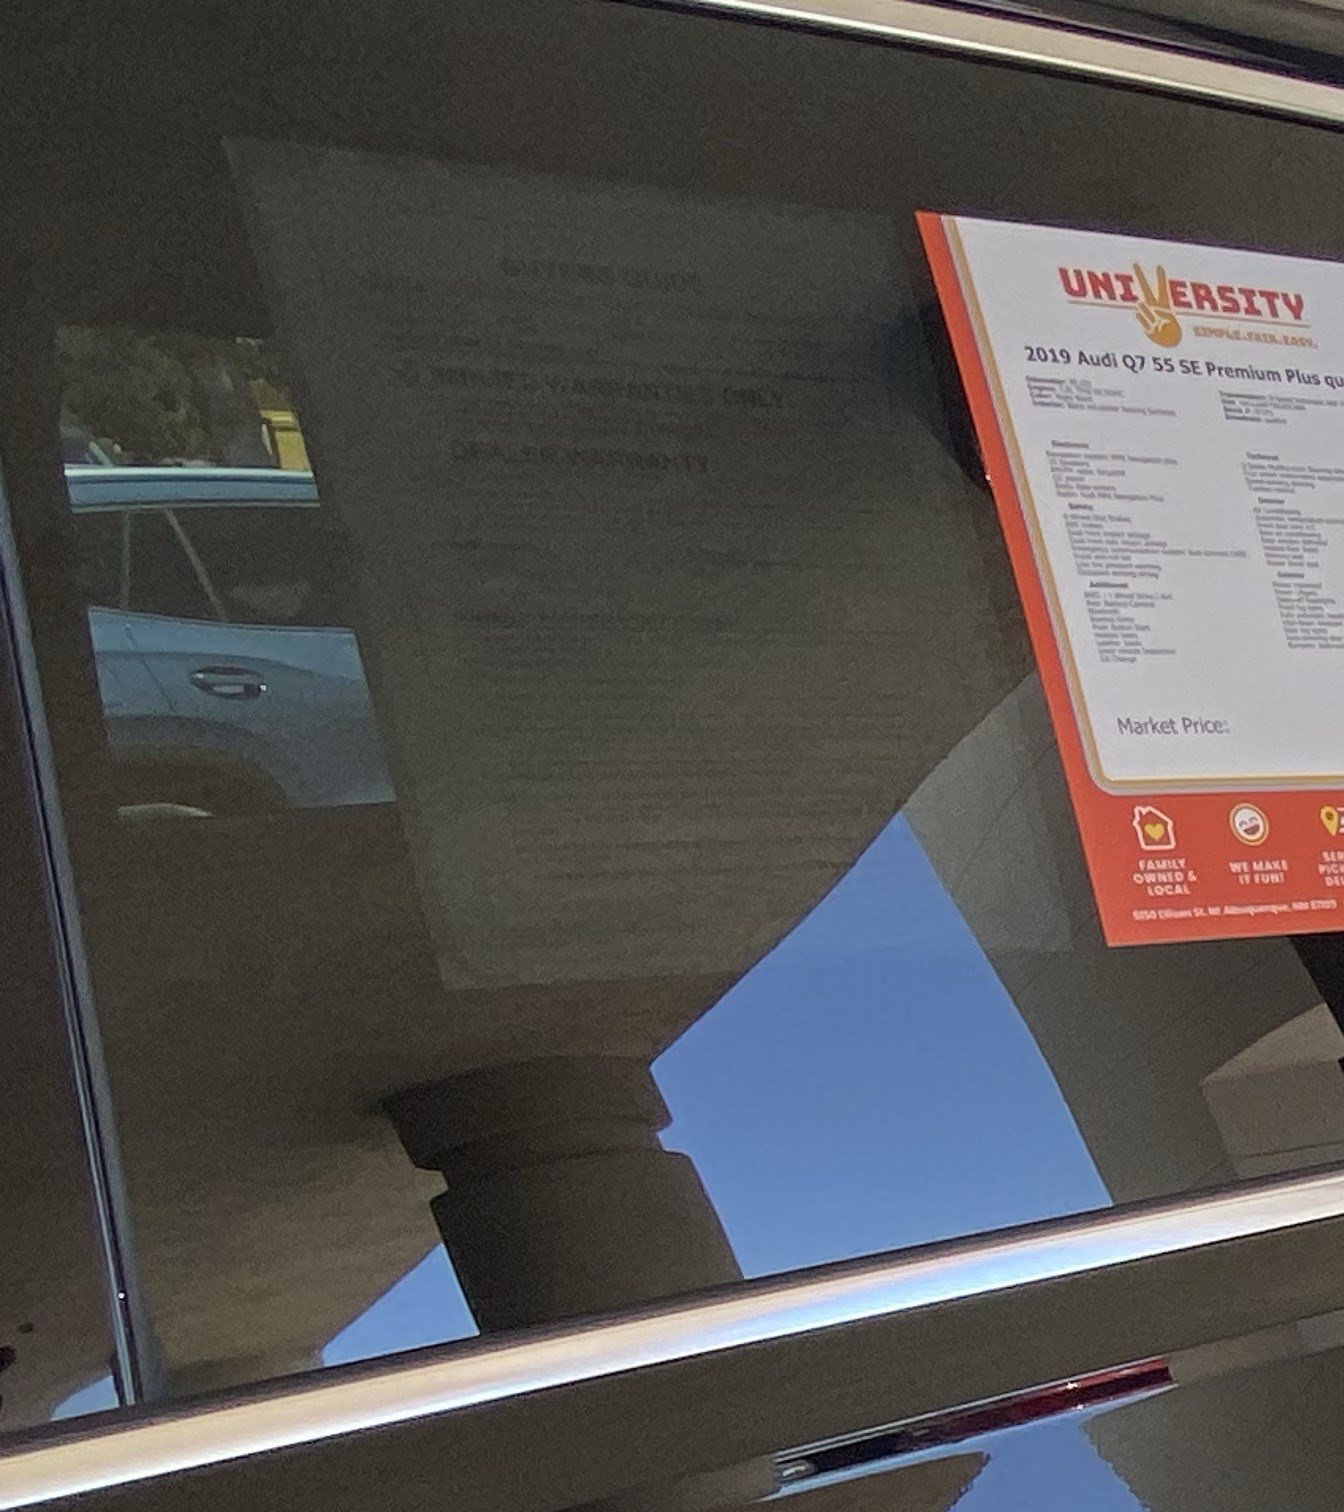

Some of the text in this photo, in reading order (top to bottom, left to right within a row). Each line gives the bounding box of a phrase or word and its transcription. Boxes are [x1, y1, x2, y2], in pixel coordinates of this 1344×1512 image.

[1024, 346, 1071, 364] 2019
[1078, 350, 1118, 369] Audi
[1122, 354, 1146, 372] Q7
[1152, 356, 1175, 373] 55
[1181, 359, 1203, 376] SE
[1206, 362, 1282, 383] Premium
[1286, 368, 1321, 387] Plus
[1117, 716, 1231, 735] Market Price:
[1138, 858, 1187, 870] FAMILY
[1229, 859, 1289, 873] WE MAKE
[1133, 871, 1184, 884] OWNED
[1147, 884, 1191, 896] LOCAL
